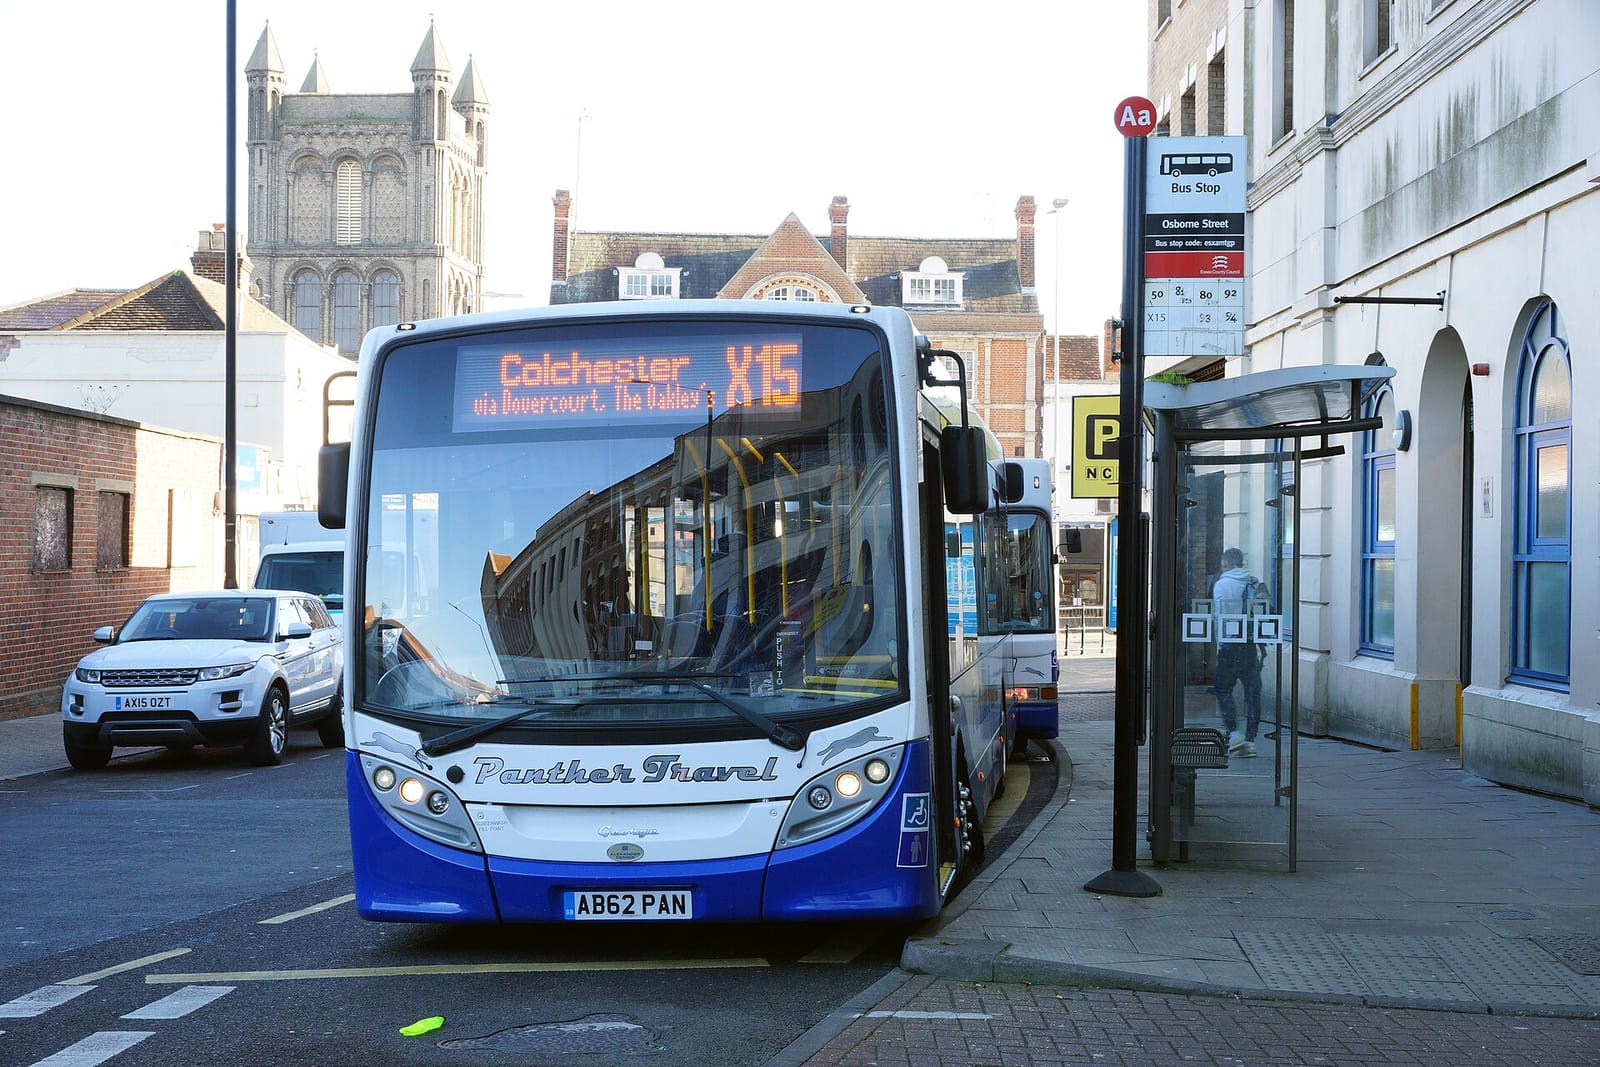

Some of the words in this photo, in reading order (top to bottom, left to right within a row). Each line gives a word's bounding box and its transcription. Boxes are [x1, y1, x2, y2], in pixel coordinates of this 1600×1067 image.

[1119, 105, 1152, 127] Aa
[1171, 183, 1192, 193] Bus
[1195, 182, 1221, 195] Stop
[1162, 219, 1200, 229] Osborne
[1202, 219, 1229, 228] Street
[1169, 239, 1184, 248] stop
[1184, 239, 1203, 247] code:
[1151, 290, 1164, 300] 50
[1199, 290, 1213, 299] 80
[1224, 289, 1238, 299] 92
[1147, 313, 1166, 322] X15
[501, 352, 690, 387] Colchester
[726, 343, 799, 408] X15
[473, 392, 498, 416] via
[614, 384, 642, 411] The
[1094, 419, 1120, 455] P
[124, 698, 148, 708] AX15
[150, 697, 172, 708] OZT
[473, 757, 636, 785] Panther
[642, 754, 779, 784] Travel
[577, 894, 635, 915] AB62
[642, 894, 686, 915] PAN
